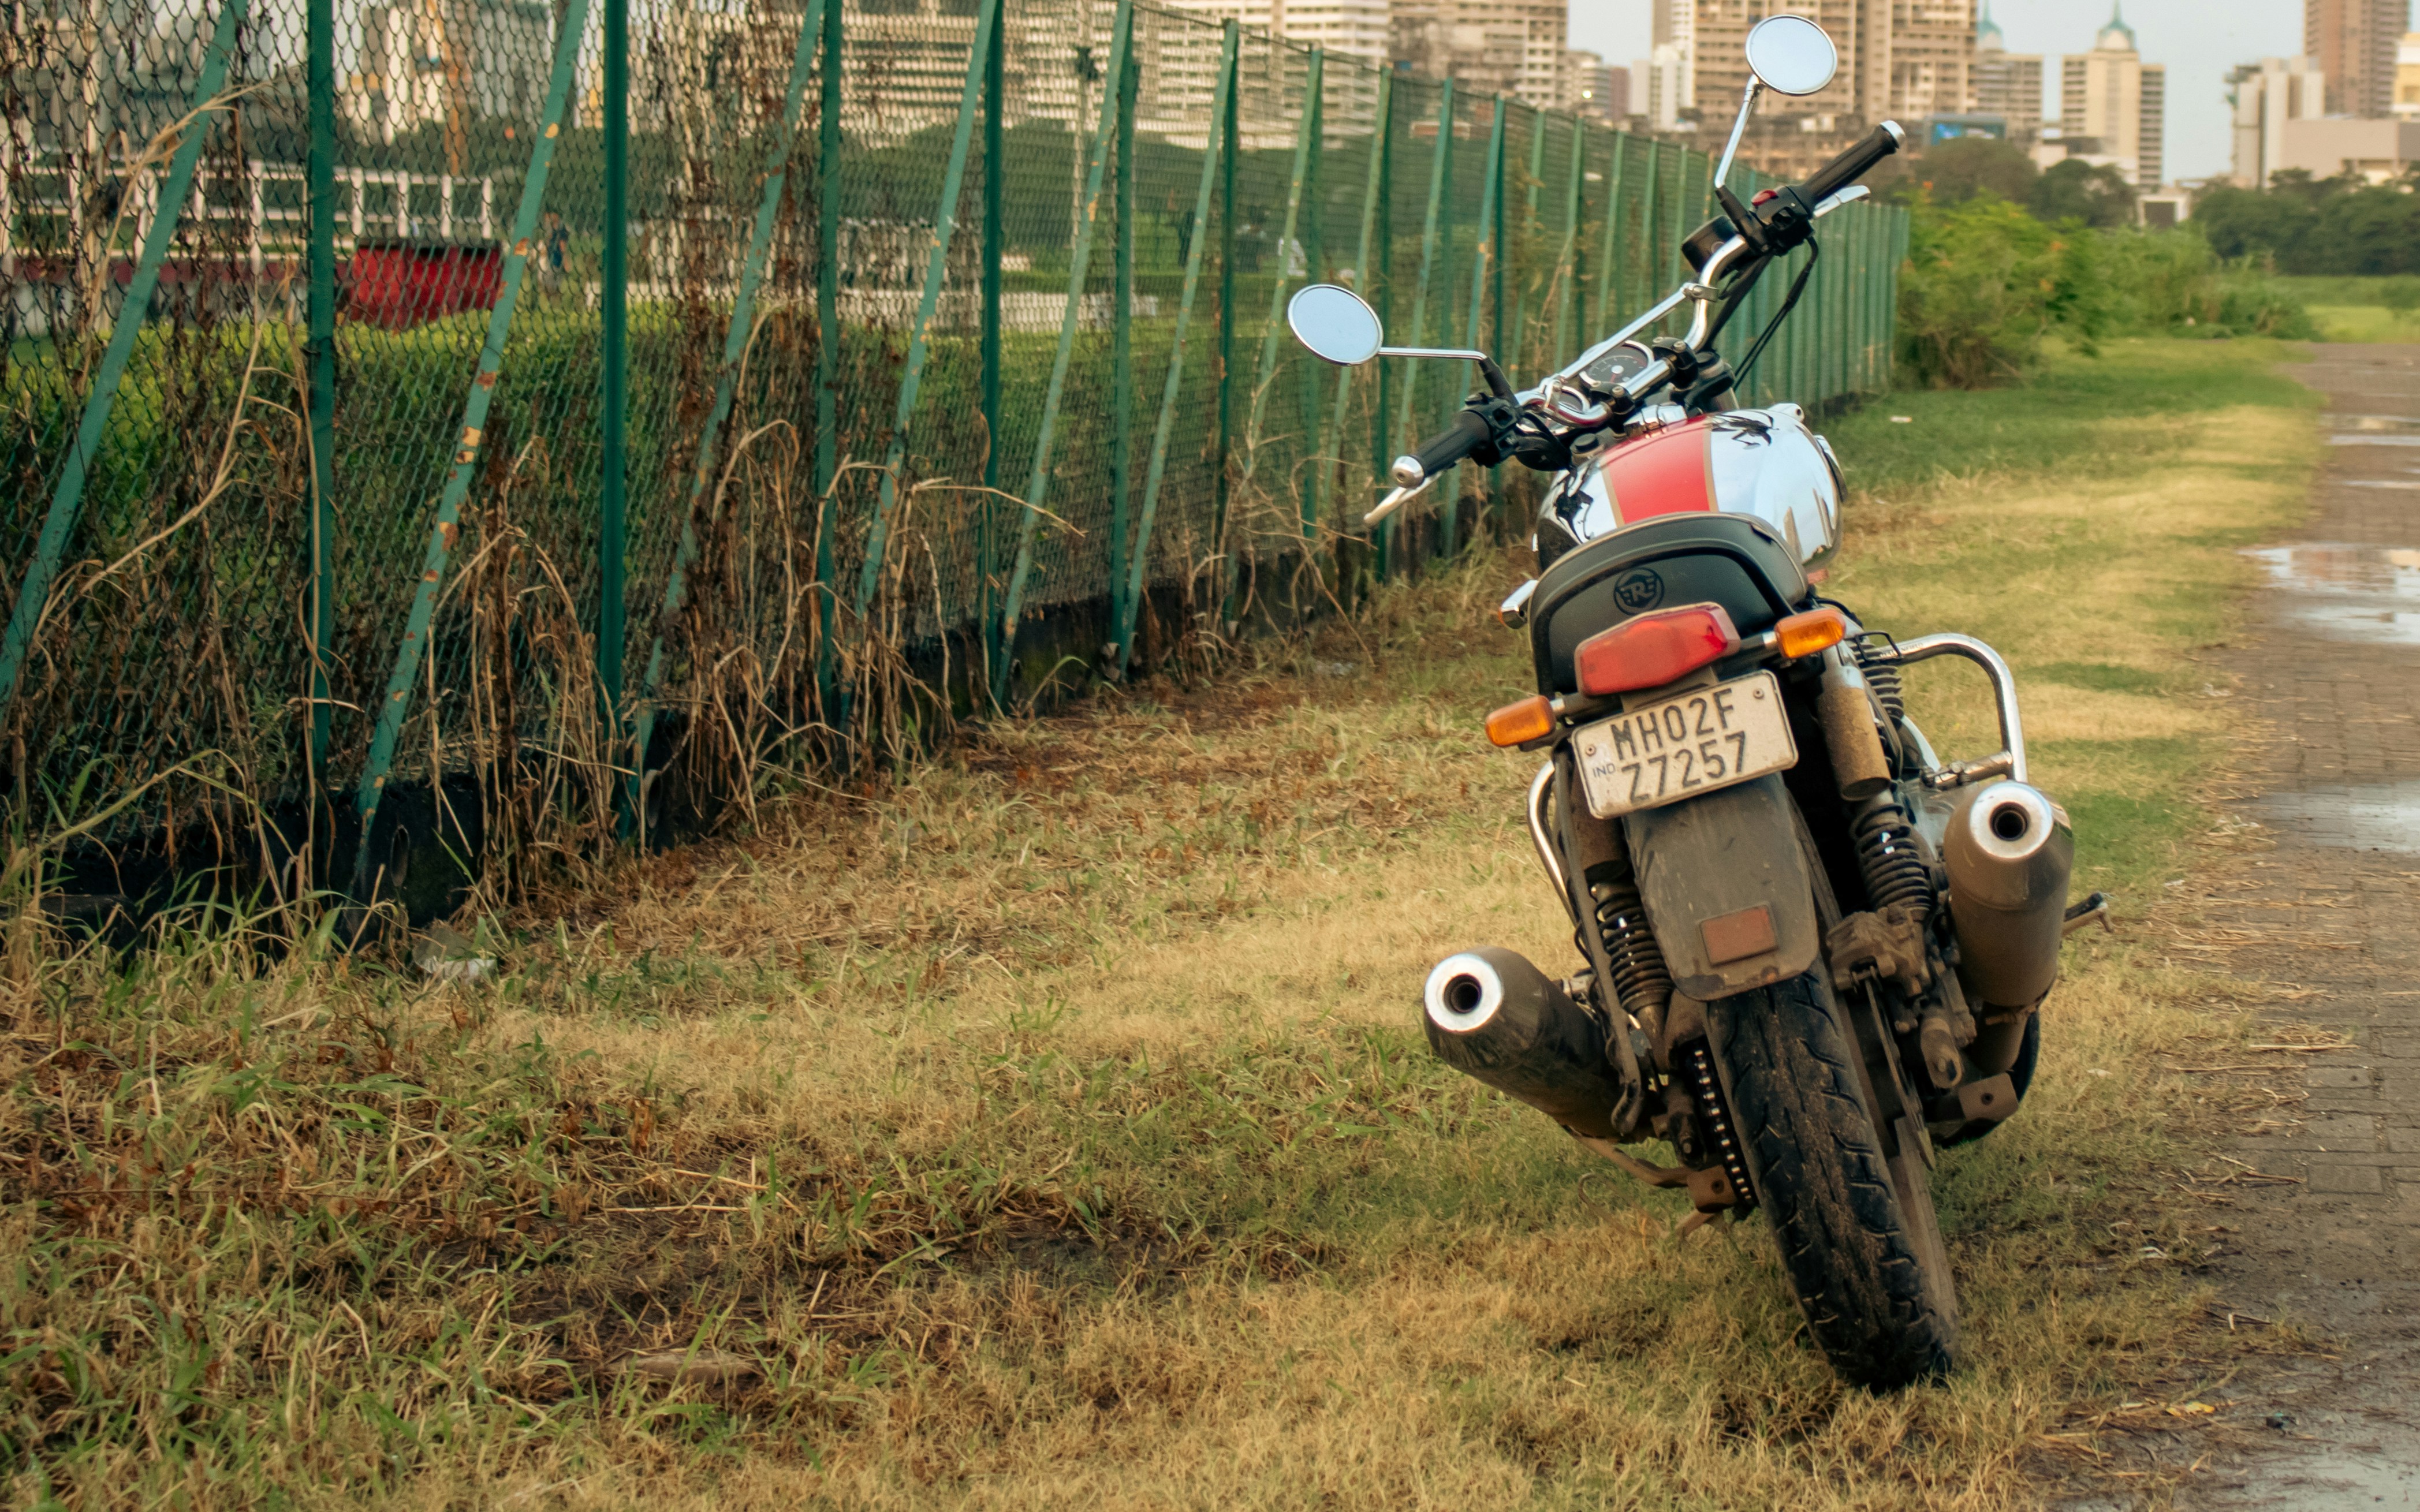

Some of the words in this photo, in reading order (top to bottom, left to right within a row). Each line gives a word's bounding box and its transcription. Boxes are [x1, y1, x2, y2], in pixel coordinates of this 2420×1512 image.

[1610, 688, 1733, 760] MH02F
[1592, 763, 1616, 778] IND
[1621, 731, 1746, 804] Z7257
